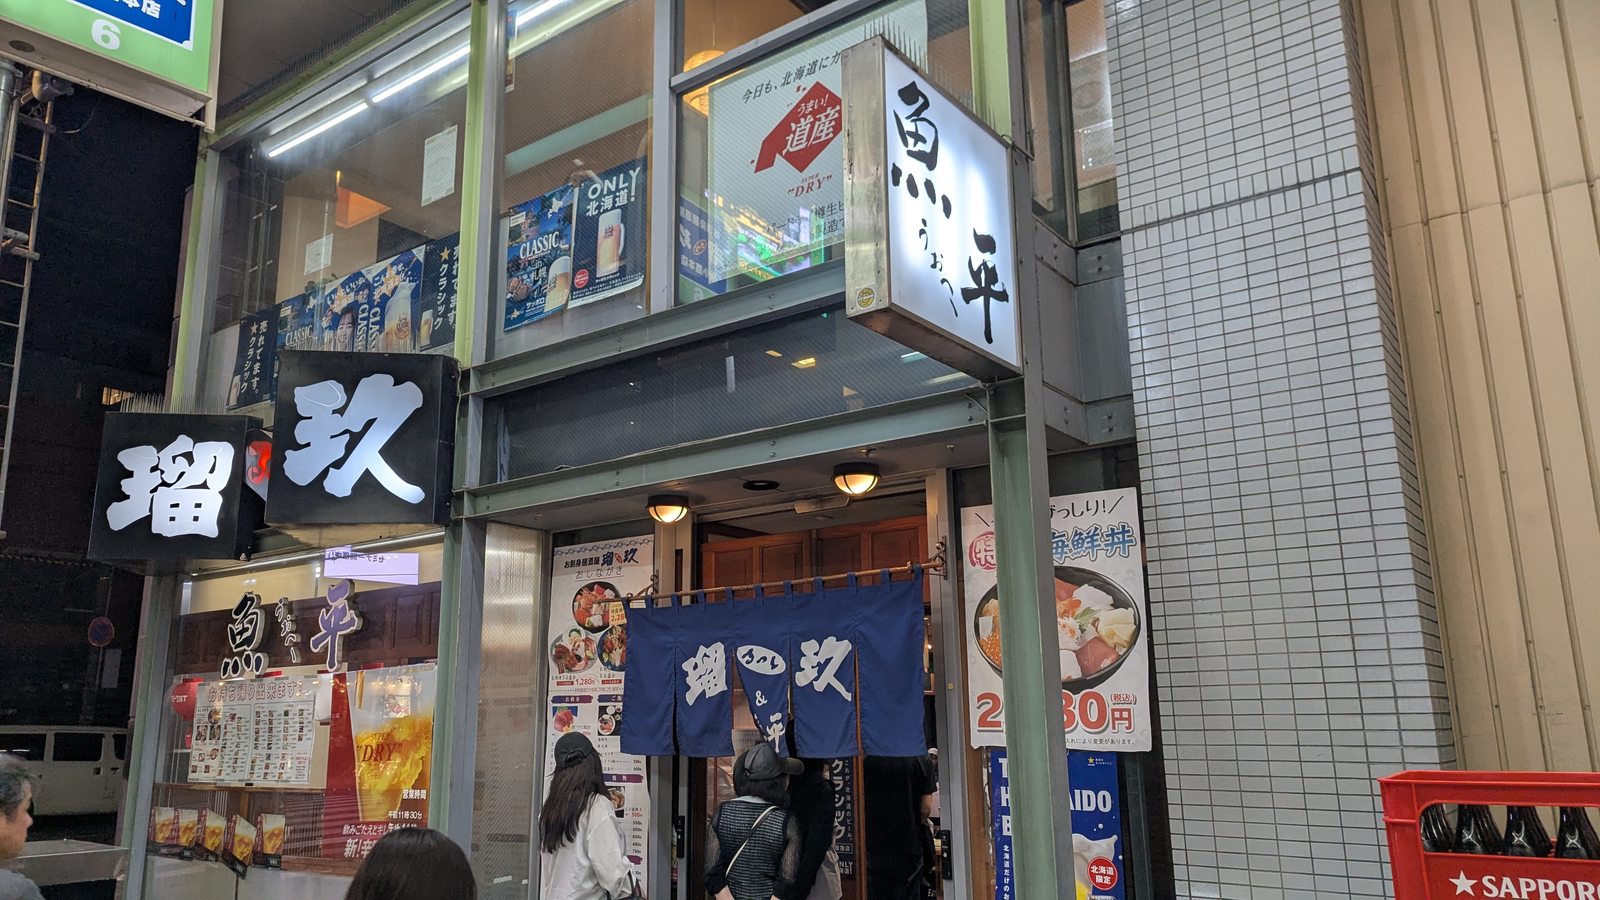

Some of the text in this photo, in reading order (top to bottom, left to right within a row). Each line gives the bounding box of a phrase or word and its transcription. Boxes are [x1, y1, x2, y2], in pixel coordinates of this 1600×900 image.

[91, 19, 121, 50] 6
[798, 94, 829, 117] うまい!
[782, 105, 840, 156] 道産
[587, 167, 641, 199] ONLY
[891, 80, 1009, 344] 魚 平
[520, 231, 560, 259] CLASSIC
[434, 263, 448, 330] クラシック
[240, 336, 256, 394] クラシック
[251, 320, 268, 394] 売れてます。
[283, 373, 425, 504] 玖
[106, 434, 235, 538] 瑠
[576, 566, 622, 579] おしながき
[220, 591, 268, 679] 魚
[311, 579, 361, 672] 平
[682, 641, 728, 706] 瑠
[795, 636, 852, 702] 玖
[755, 690, 768, 706] &
[370, 732, 392, 741] SUPER
[402, 789, 427, 800] 営業時間
[832, 759, 846, 840] クラシック
[1090, 865, 1114, 876] 北海道
[1095, 875, 1112, 885] 限定
